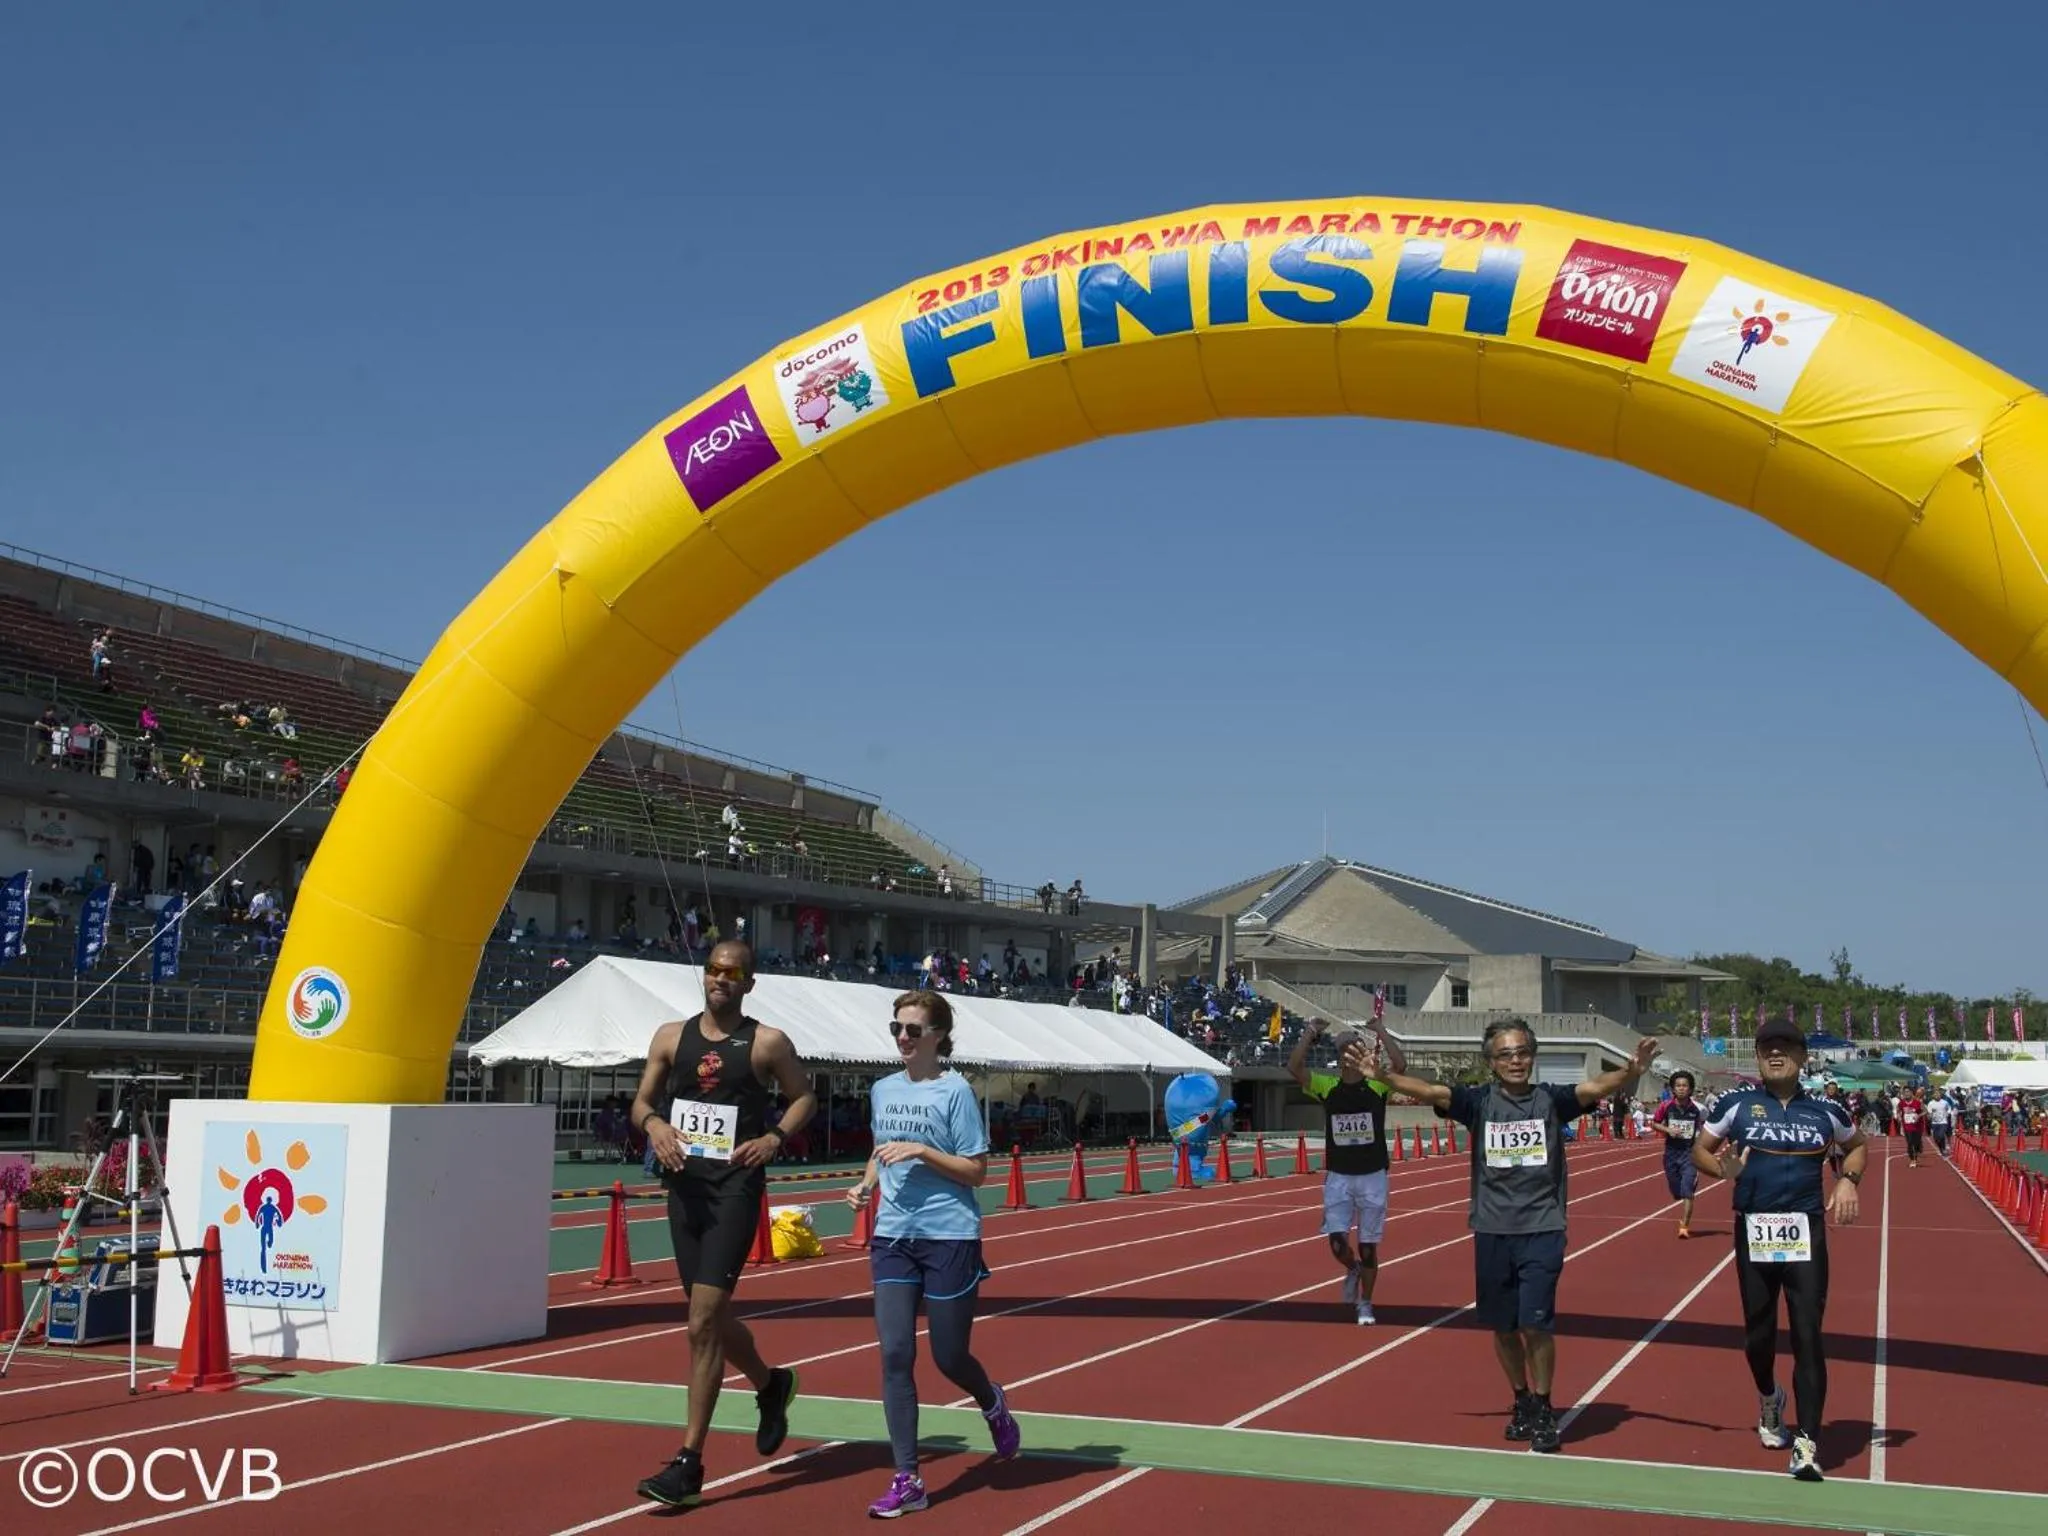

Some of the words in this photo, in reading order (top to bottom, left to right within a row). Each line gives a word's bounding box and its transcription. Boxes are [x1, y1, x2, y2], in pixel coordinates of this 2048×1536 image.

[917, 265, 1010, 314] 2013
[1021, 220, 1226, 275] OKINAWA
[1243, 212, 1522, 243] MARATHON
[901, 234, 1526, 398] FINISH
[1563, 308, 1635, 336] オリオンビール
[781, 333, 858, 378] docomo
[1704, 367, 1758, 391] MARATHON
[1712, 360, 1757, 383] OKINAWA
[680, 1112, 725, 1136] 1312
[1337, 1120, 1368, 1133] 2416
[1490, 1130, 1543, 1149] 11392
[1745, 1127, 1825, 1147] ZANPA
[1756, 1215, 1794, 1225] docomo
[1753, 1225, 1801, 1242] 3140
[273, 1261, 313, 1270] MARATHON
[222, 1277, 326, 1300] きなわマラソン
